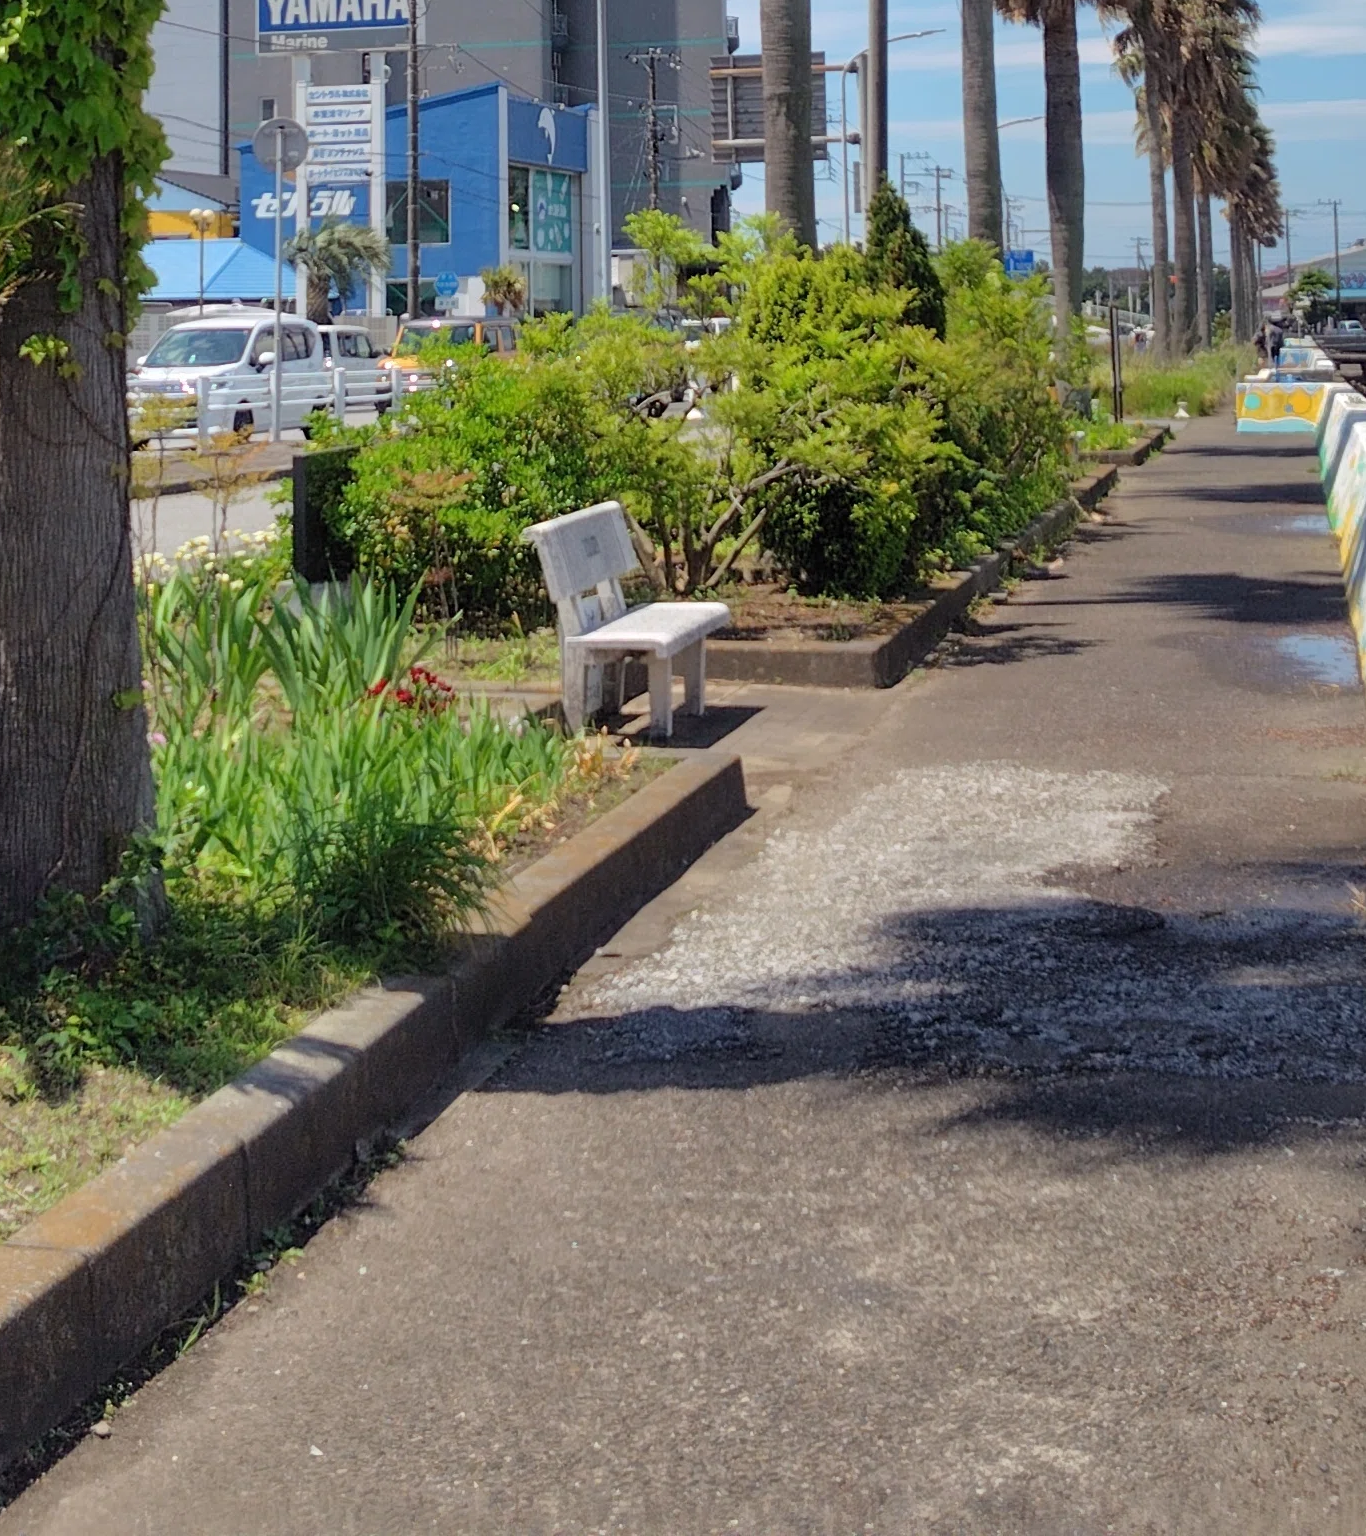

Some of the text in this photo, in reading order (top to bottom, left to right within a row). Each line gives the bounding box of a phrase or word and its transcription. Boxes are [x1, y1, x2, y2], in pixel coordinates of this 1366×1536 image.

[271, 34, 328, 50] Marine
[251, 190, 357, 219] センラル
